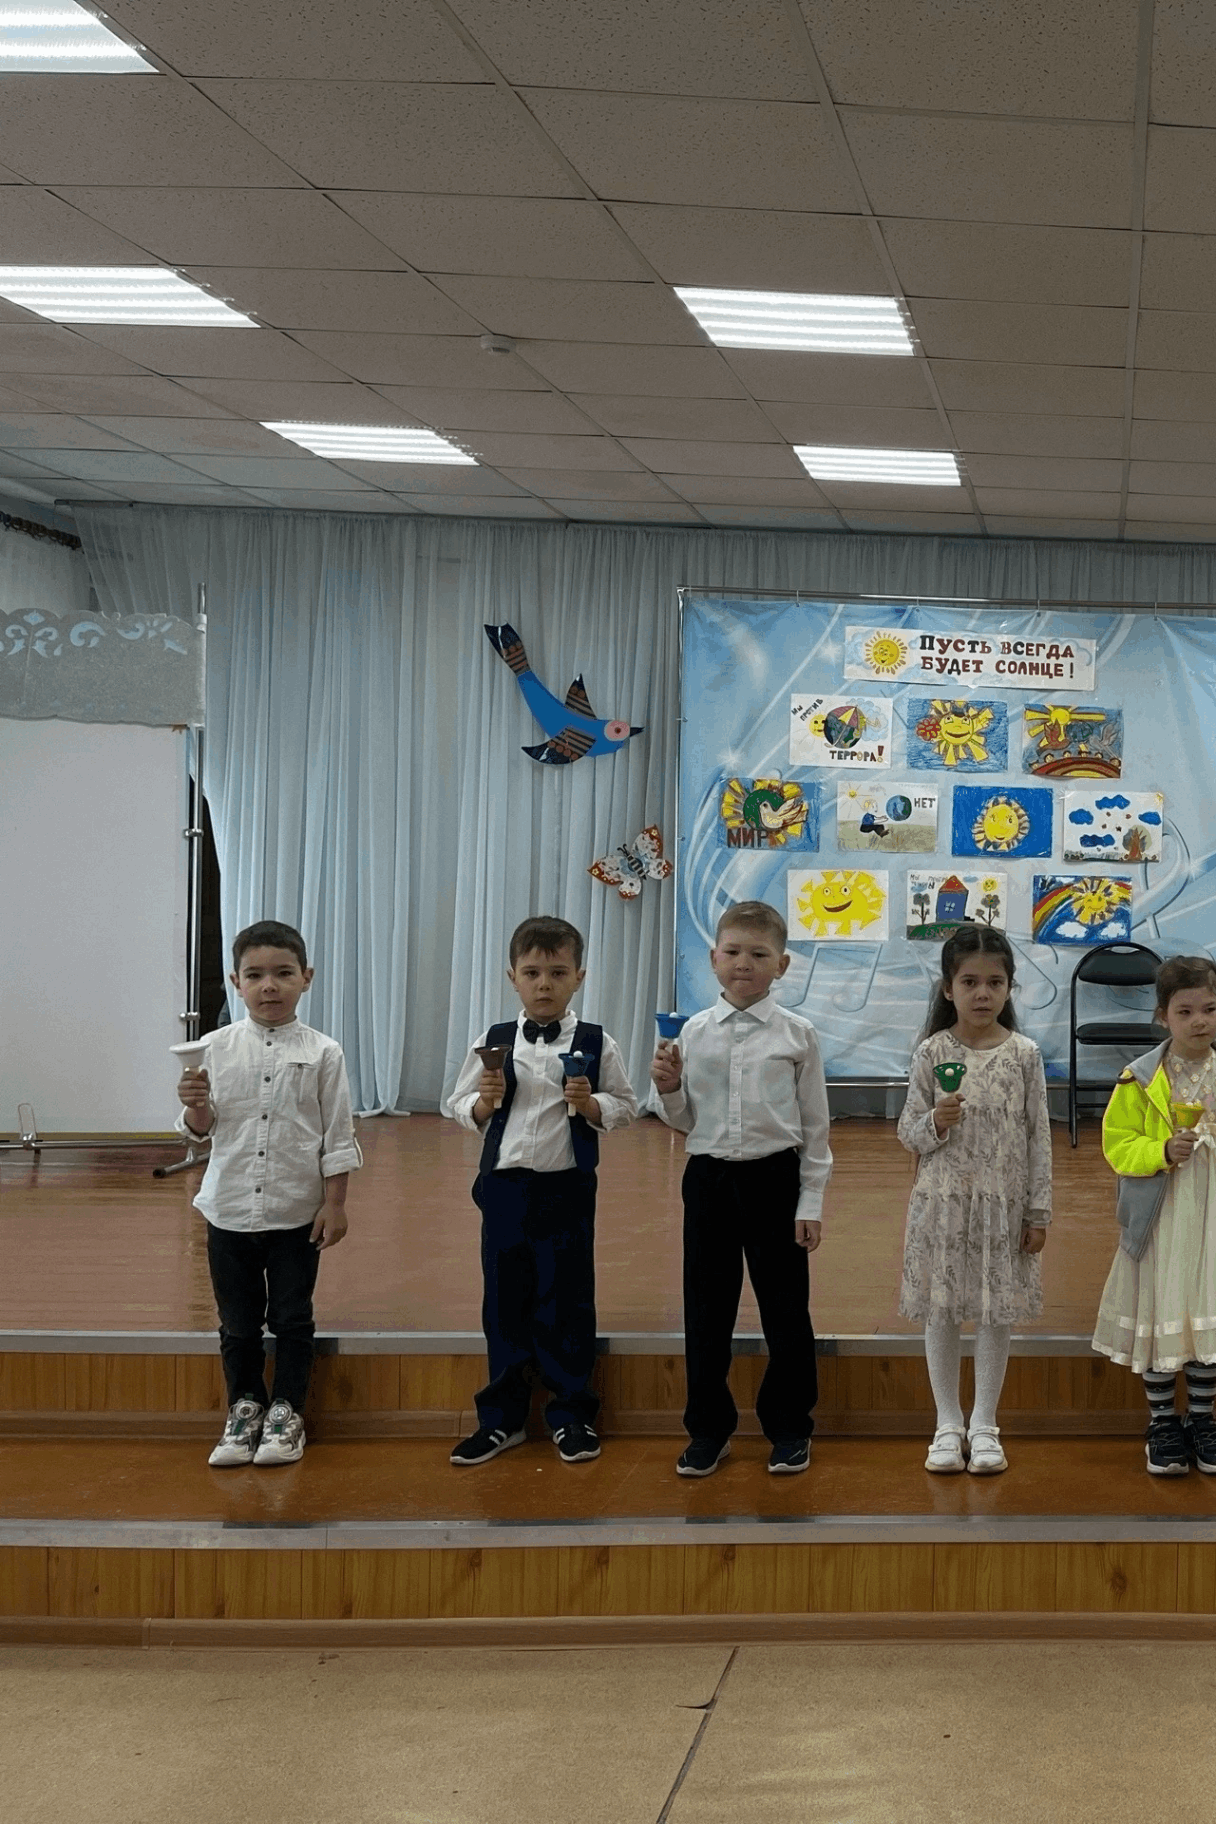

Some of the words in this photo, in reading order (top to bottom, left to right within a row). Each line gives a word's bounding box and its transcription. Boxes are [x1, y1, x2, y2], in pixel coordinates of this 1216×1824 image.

[1000, 641, 1075, 660] ВСЕГДА
[920, 656, 983, 676] БУДЕТ
[829, 745, 885, 763] ТЕРРОРА!
[914, 797, 936, 809] НЕТ
[727, 827, 769, 849] МИР
